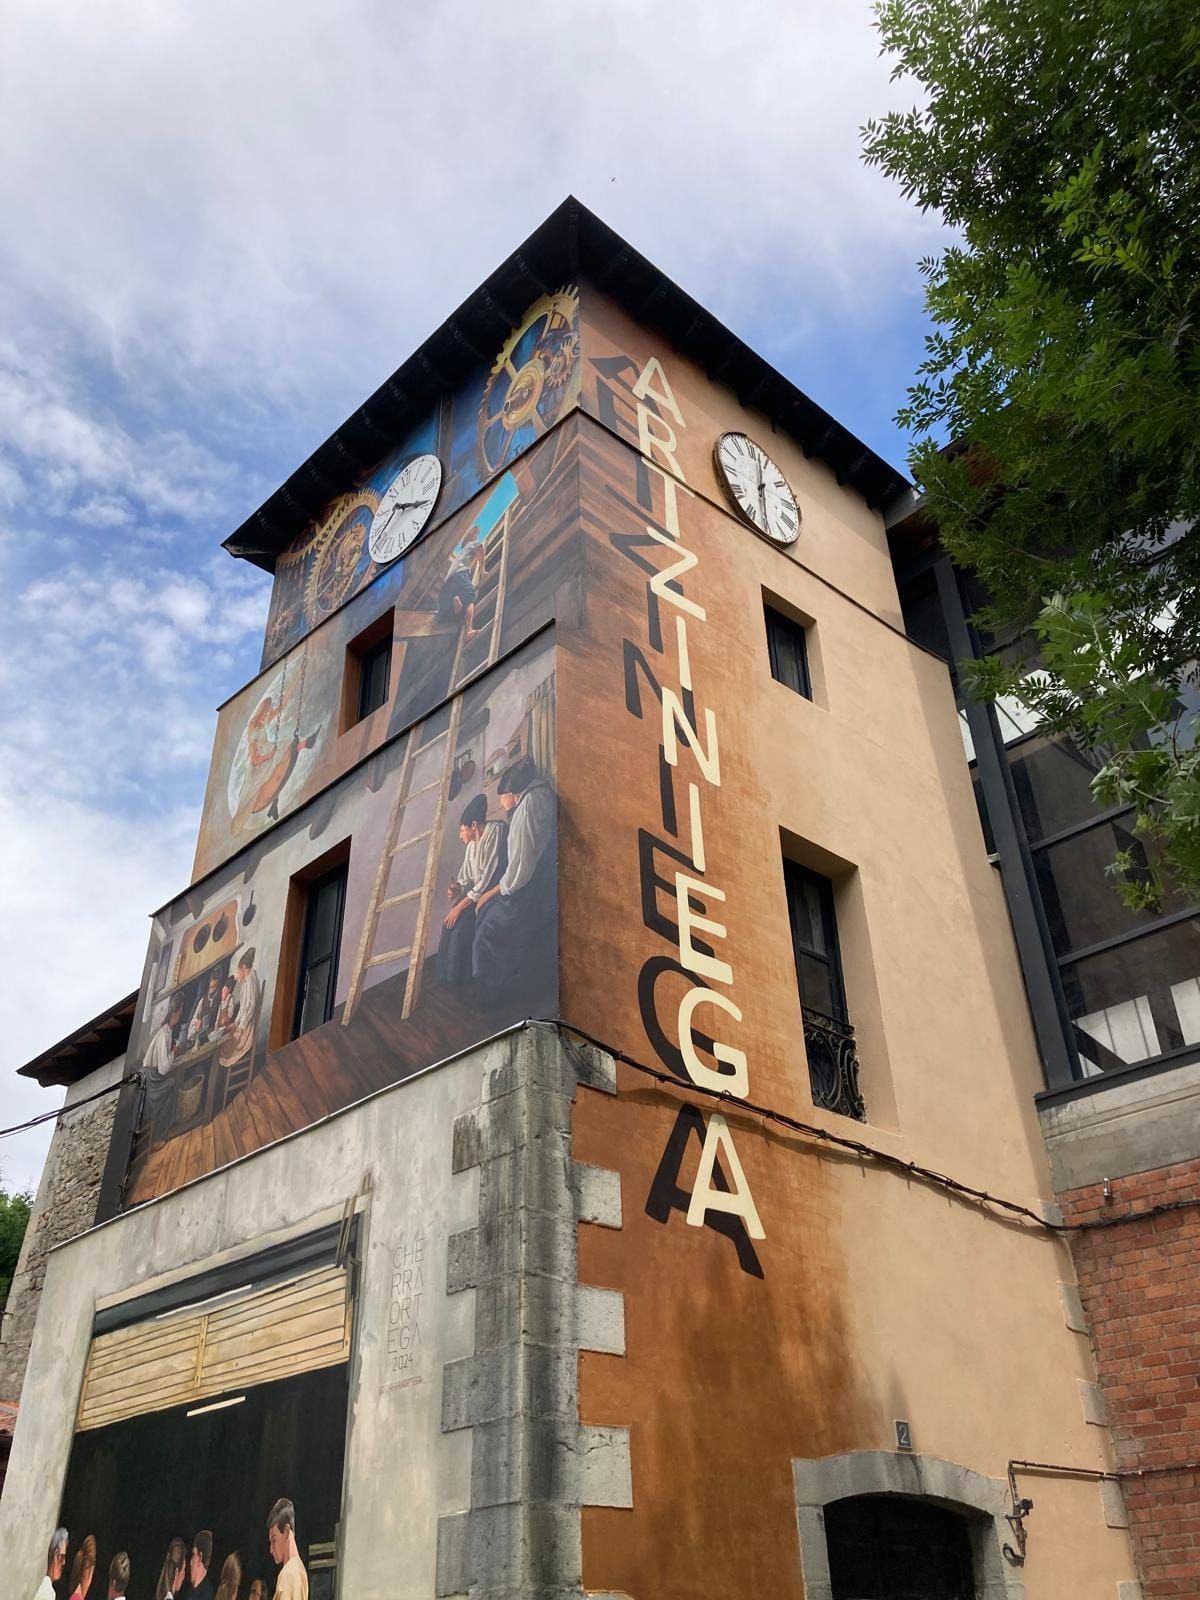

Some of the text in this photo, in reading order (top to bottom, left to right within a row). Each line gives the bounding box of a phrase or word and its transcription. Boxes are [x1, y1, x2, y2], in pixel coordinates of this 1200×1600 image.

[632, 356, 767, 1241] ARTZINIEGA
[393, 1238, 425, 1269] CHE
[389, 1292, 424, 1326] ORT
[391, 1353, 414, 1373] 2024
[899, 1424, 909, 1443] 2
